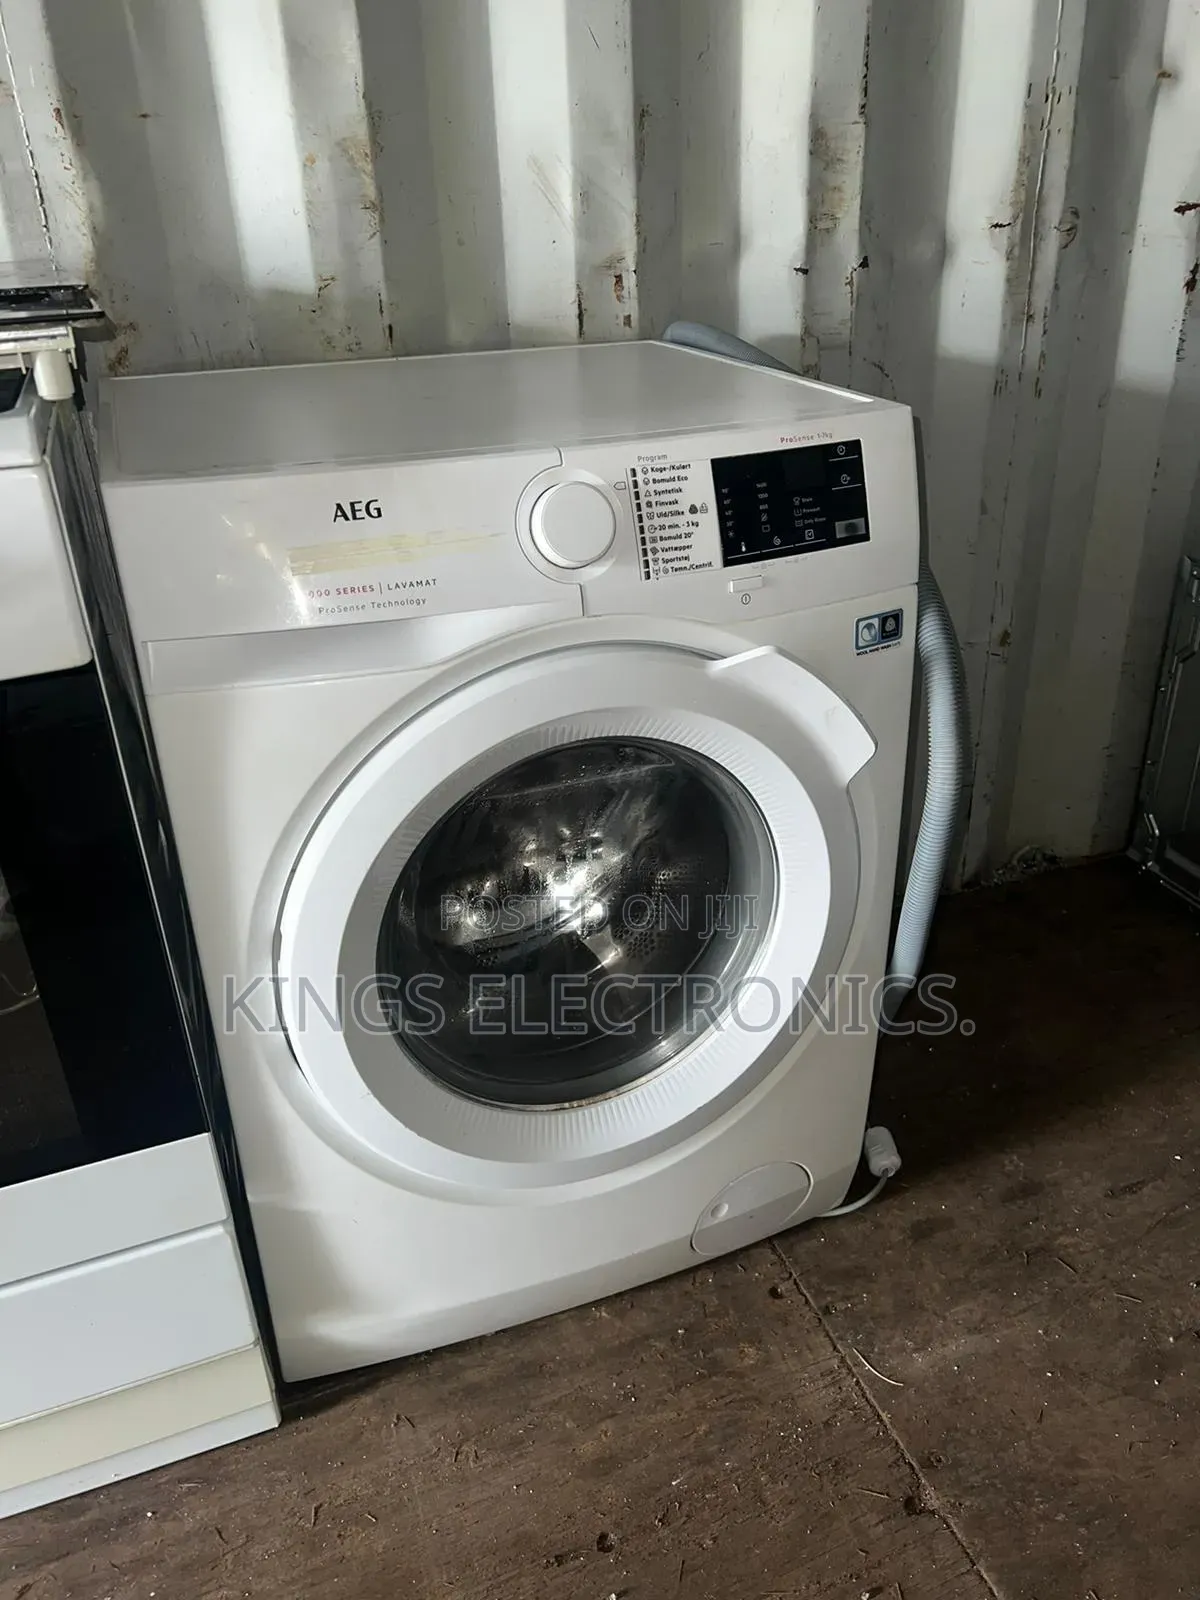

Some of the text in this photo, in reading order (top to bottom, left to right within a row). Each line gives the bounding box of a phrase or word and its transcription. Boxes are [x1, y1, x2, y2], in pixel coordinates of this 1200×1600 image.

[780, 434, 814, 443] ProSense
[637, 454, 667, 462] Program
[653, 487, 682, 496] Syntetisk
[655, 499, 679, 507] Finvask
[333, 499, 382, 523] AEG
[656, 510, 685, 518] Uld/Silke
[692, 520, 699, 528] kg
[659, 533, 683, 542] Bomuld
[660, 544, 693, 553] Vattæpper
[662, 555, 690, 564] Sportstøj
[336, 584, 375, 596] SERIES
[387, 578, 437, 591] LAVAMAT
[318, 598, 427, 614] ProSense Technology
